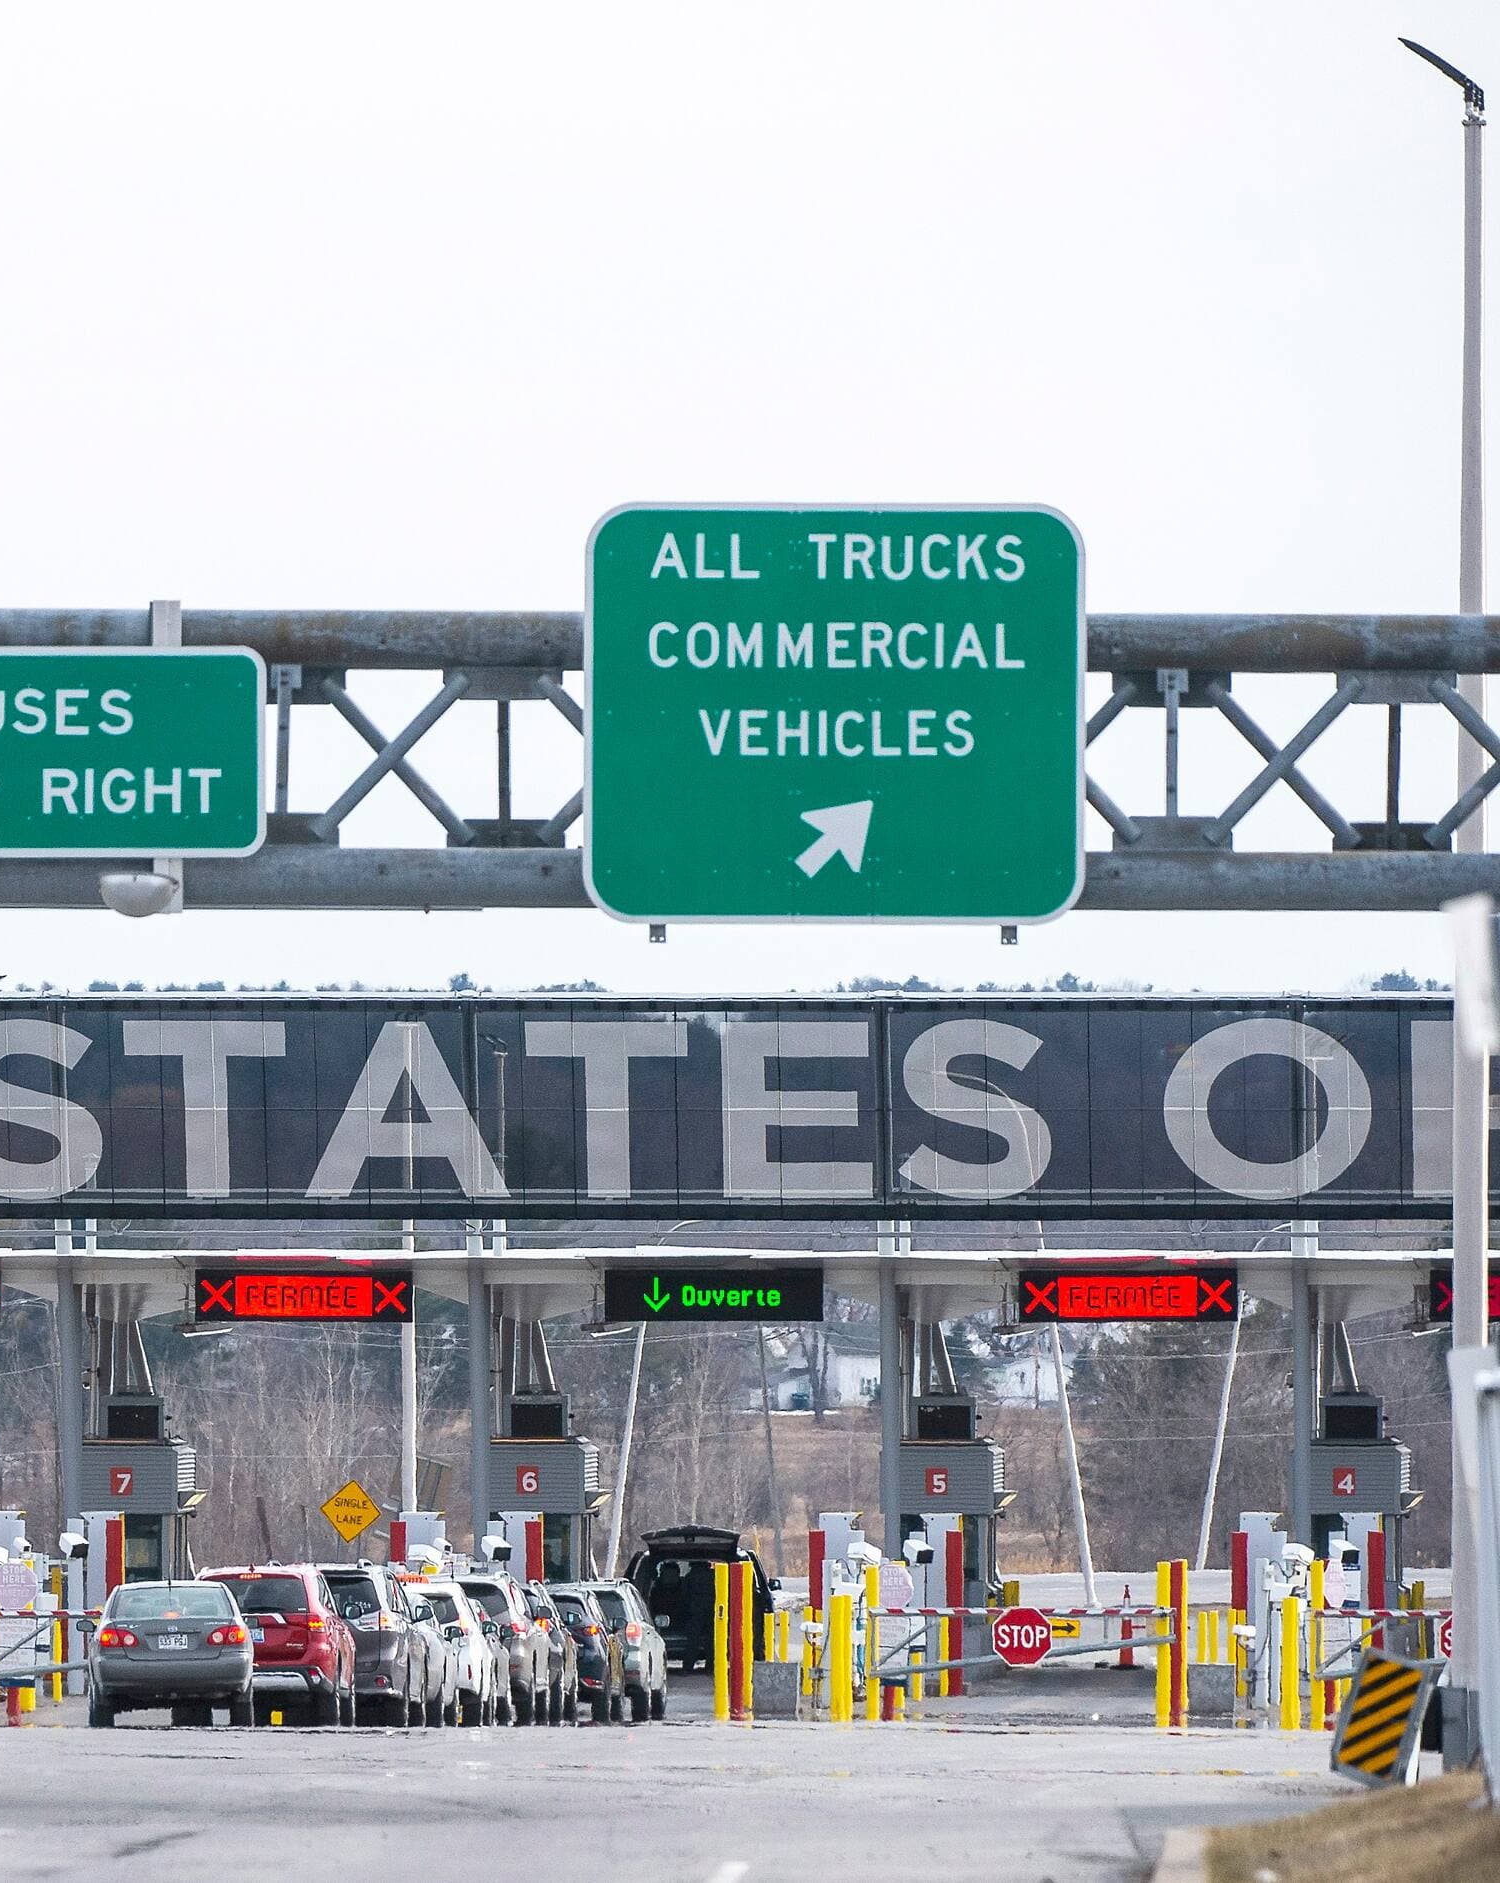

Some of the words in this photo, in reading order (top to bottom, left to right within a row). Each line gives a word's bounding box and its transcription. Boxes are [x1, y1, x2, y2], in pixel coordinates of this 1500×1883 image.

[651, 532, 760, 579] ALL
[808, 533, 1026, 582] TRUCKS
[648, 621, 1026, 669] COMMERCIAL
[699, 709, 975, 757] VEHICLES
[42, 767, 222, 814] RIGHT
[246, 1279, 358, 1309] FERMÉE
[681, 1285, 781, 1307] Ouverte
[1069, 1279, 1181, 1309] FERMÉE
[116, 1474, 132, 1493] 7
[522, 1471, 538, 1492] 6
[931, 1474, 947, 1493] 5
[1337, 1474, 1355, 1494] 4
[334, 1497, 368, 1509] SINGLE
[336, 1514, 362, 1525] LANE
[2, 1566, 26, 1575] STOP
[2, 1575, 26, 1584] HERE
[997, 1624, 1048, 1648] STOP
